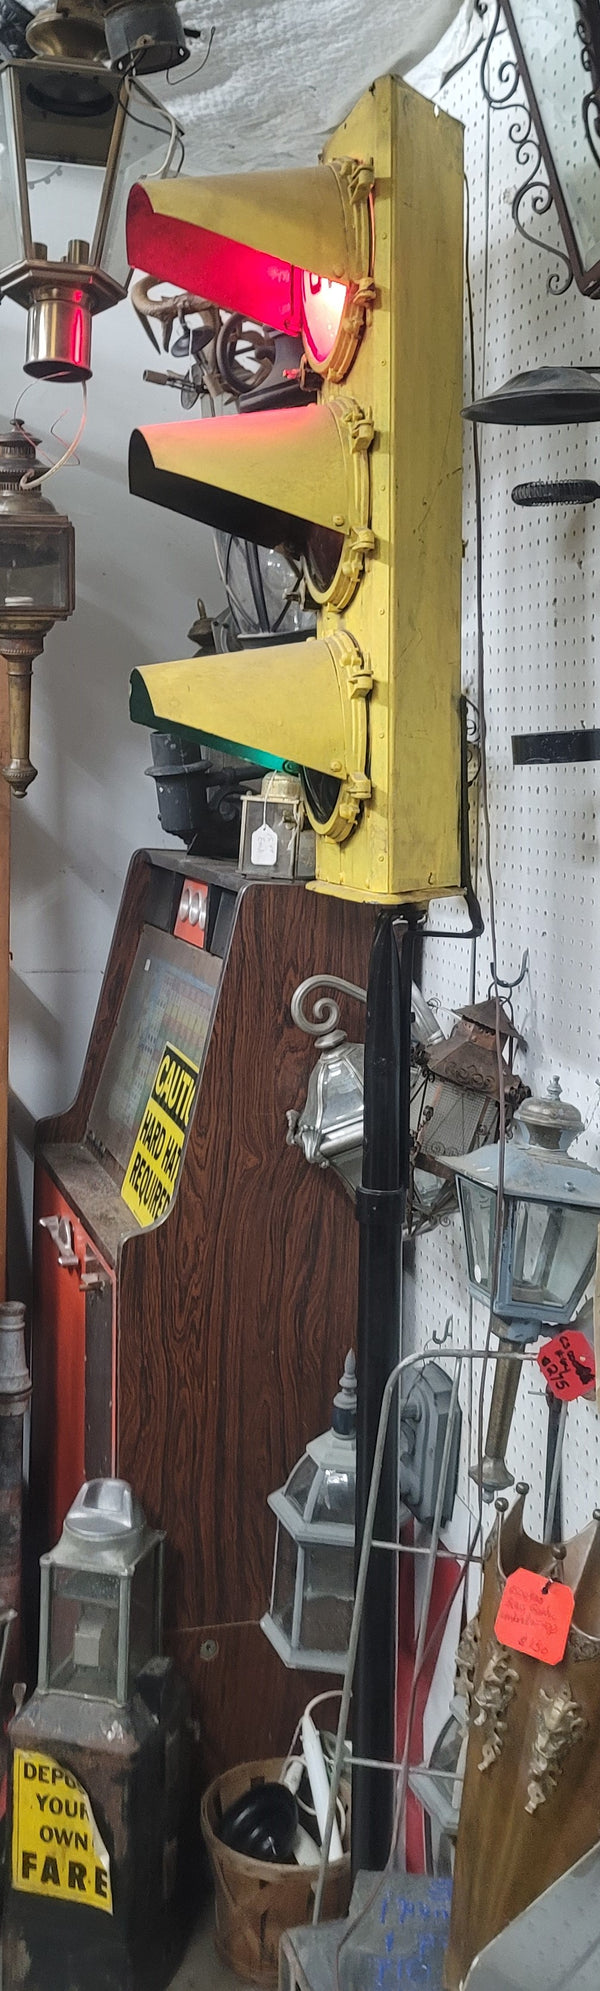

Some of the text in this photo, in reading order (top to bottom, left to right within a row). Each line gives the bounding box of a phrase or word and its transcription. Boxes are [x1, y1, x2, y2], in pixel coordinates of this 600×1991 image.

[139, 1109, 182, 1183] HARD HAT
[39, 1825, 88, 1851] OWN
[22, 1851, 108, 1899] FARE
